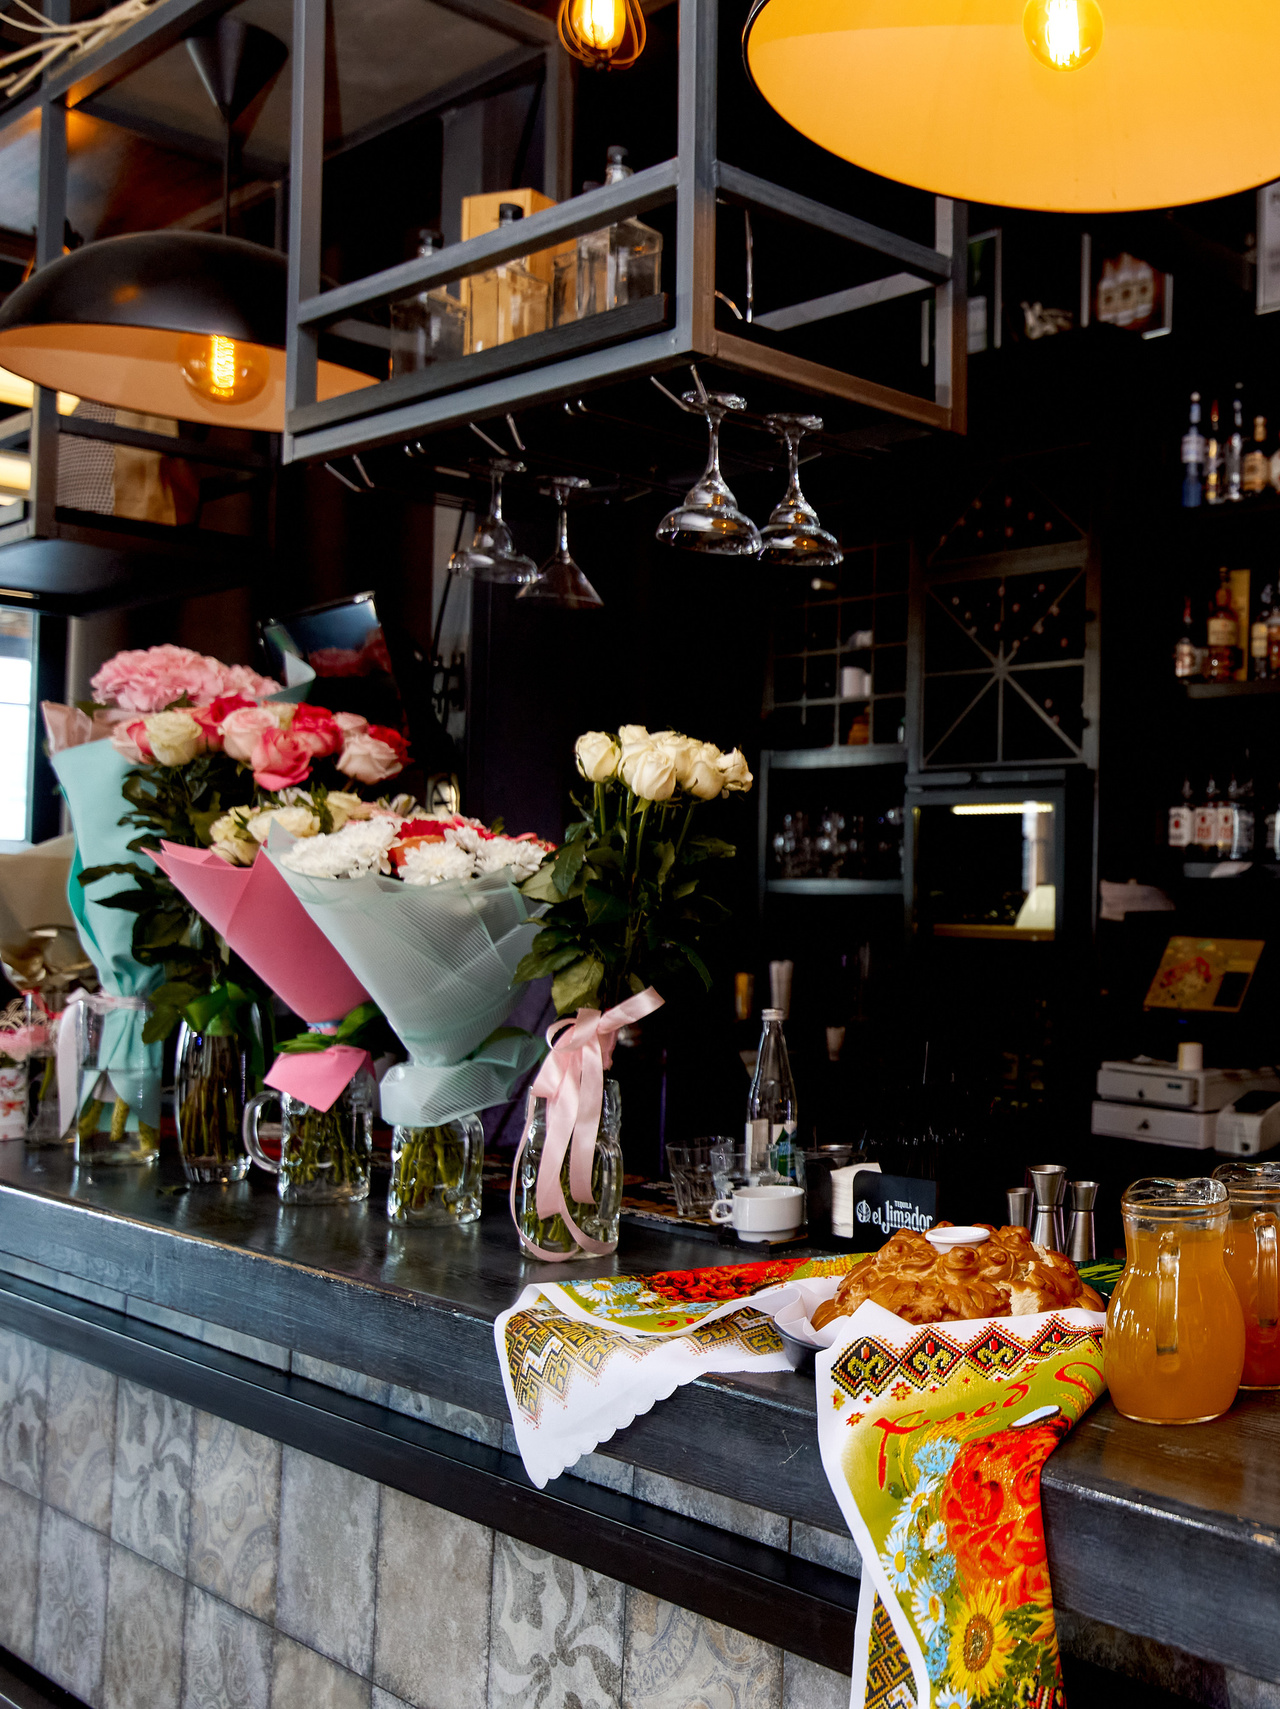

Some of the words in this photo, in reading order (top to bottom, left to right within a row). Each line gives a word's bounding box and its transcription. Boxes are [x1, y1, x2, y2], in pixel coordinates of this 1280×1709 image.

[894, 1200, 912, 1209] TEQUILA
[872, 1207, 881, 1226] el
[881, 1200, 934, 1234] Jimador
